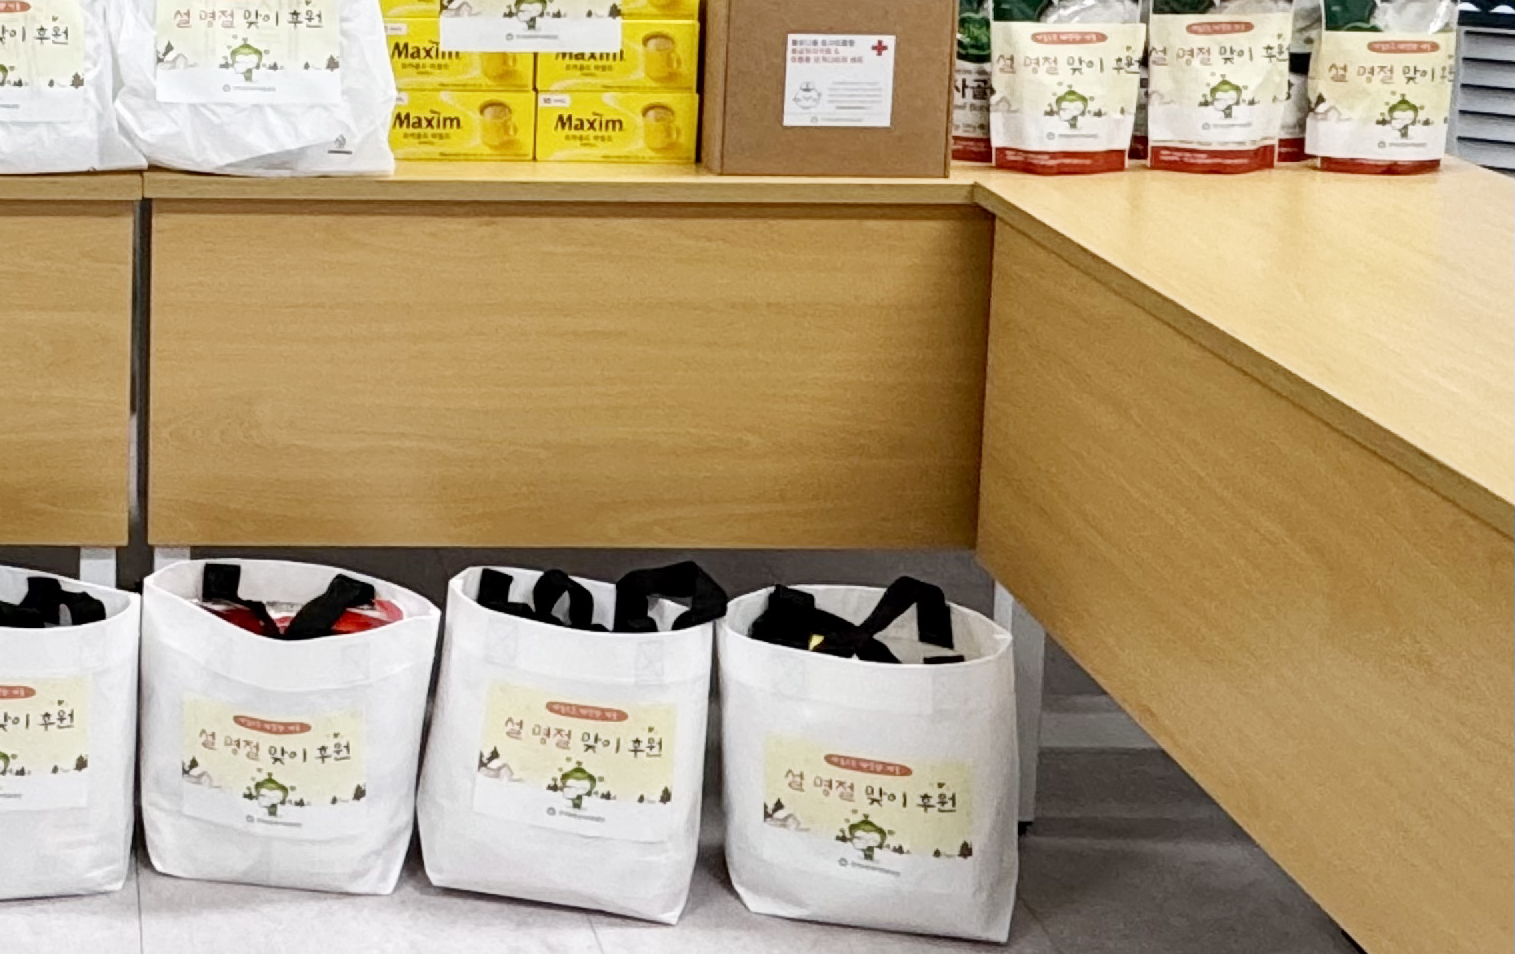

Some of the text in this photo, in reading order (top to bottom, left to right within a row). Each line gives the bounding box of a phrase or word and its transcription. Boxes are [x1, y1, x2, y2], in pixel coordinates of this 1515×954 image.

[174, 9, 324, 29] 설 명절 맞이 후원
[34, 25, 69, 45] 후원
[392, 109, 461, 129] Maxim
[554, 111, 624, 132] Maxim
[38, 708, 75, 731] 후원
[199, 728, 351, 765] 설 명절 맞이 후원
[505, 716, 663, 759] 설 명절 맞이 후원
[784, 768, 957, 814] 설 명절 맞이 후원
